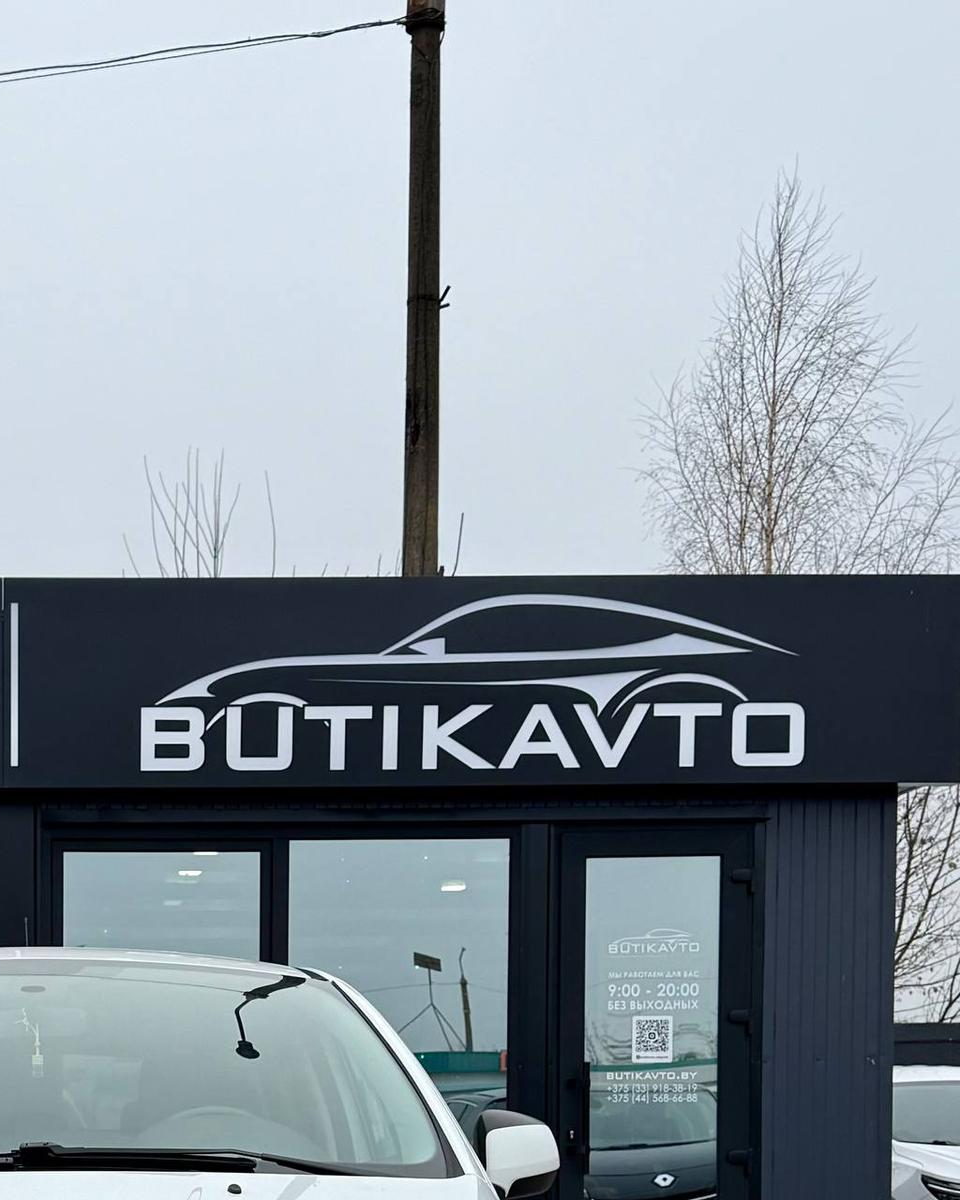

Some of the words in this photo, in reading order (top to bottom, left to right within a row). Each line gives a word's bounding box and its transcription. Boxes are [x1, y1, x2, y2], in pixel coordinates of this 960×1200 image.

[140, 701, 806, 772] BUTIKAVTO
[608, 942, 700, 954] BUTIKAVTO
[623, 971, 664, 979] РАБОТАЕМ
[608, 983, 640, 998] 9:00
[657, 983, 700, 998] 20:00
[607, 1000, 626, 1010] БЕЗ
[630, 1000, 699, 1011] ВЫХОДНЫХ
[606, 1071, 698, 1080] BUTIKAVTO.BY
[607, 1083, 630, 1093] +375
[632, 1083, 649, 1095] (33)
[652, 1083, 698, 1093] 918-38-19
[607, 1093, 630, 1103] +375
[632, 1093, 649, 1105] (44)
[652, 1093, 699, 1103] 568-66-88
